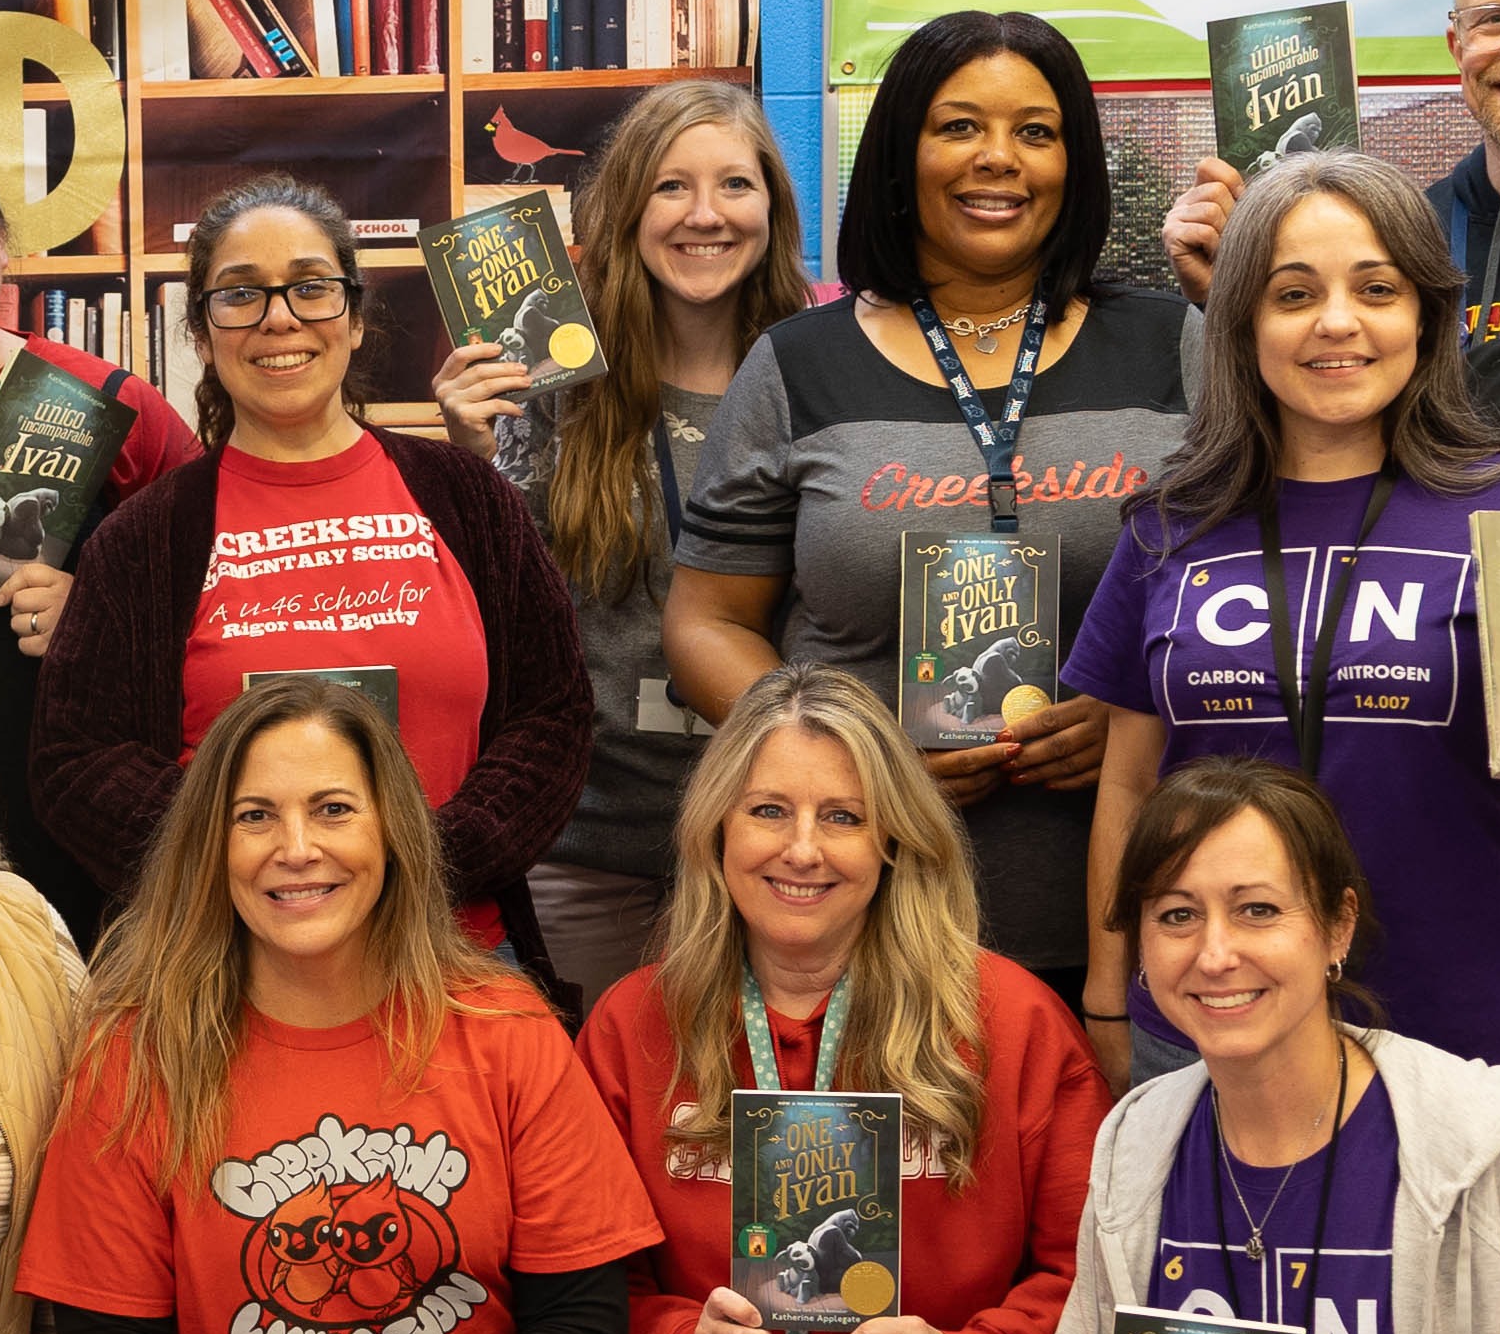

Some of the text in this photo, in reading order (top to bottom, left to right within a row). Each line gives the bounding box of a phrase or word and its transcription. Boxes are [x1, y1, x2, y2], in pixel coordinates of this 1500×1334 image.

[1245, 46, 1319, 87] incomparable
[1250, 35, 1300, 68] único
[1246, 72, 1325, 132] Iván
[355, 222, 408, 235] SCHOOL
[468, 225, 505, 262] ONE
[482, 237, 525, 281] ONLY
[472, 258, 540, 319] Ivan
[214, 512, 435, 558] CREEKSIDE
[352, 540, 439, 563] SCHOOL
[953, 553, 996, 585] ONE
[1192, 570, 1210, 587] 6
[208, 604, 228, 623] A
[309, 583, 393, 612] School
[399, 580, 431, 615] for
[961, 575, 1017, 611] ONLY
[222, 607, 420, 638] Rigor and Equity
[940, 600, 1019, 649] Ivan
[1196, 581, 1424, 646] C N
[1187, 665, 1431, 686] CARBON NITROGEN
[1203, 695, 1410, 712] 12.011 14.007
[939, 732, 978, 741] Katherine
[786, 1117, 833, 1152] ONE
[795, 1142, 856, 1180] ONLY
[773, 1169, 858, 1221] Ivan
[1164, 1256, 1307, 1288] 6 7
[772, 1313, 861, 1324] Katherine Applegate
